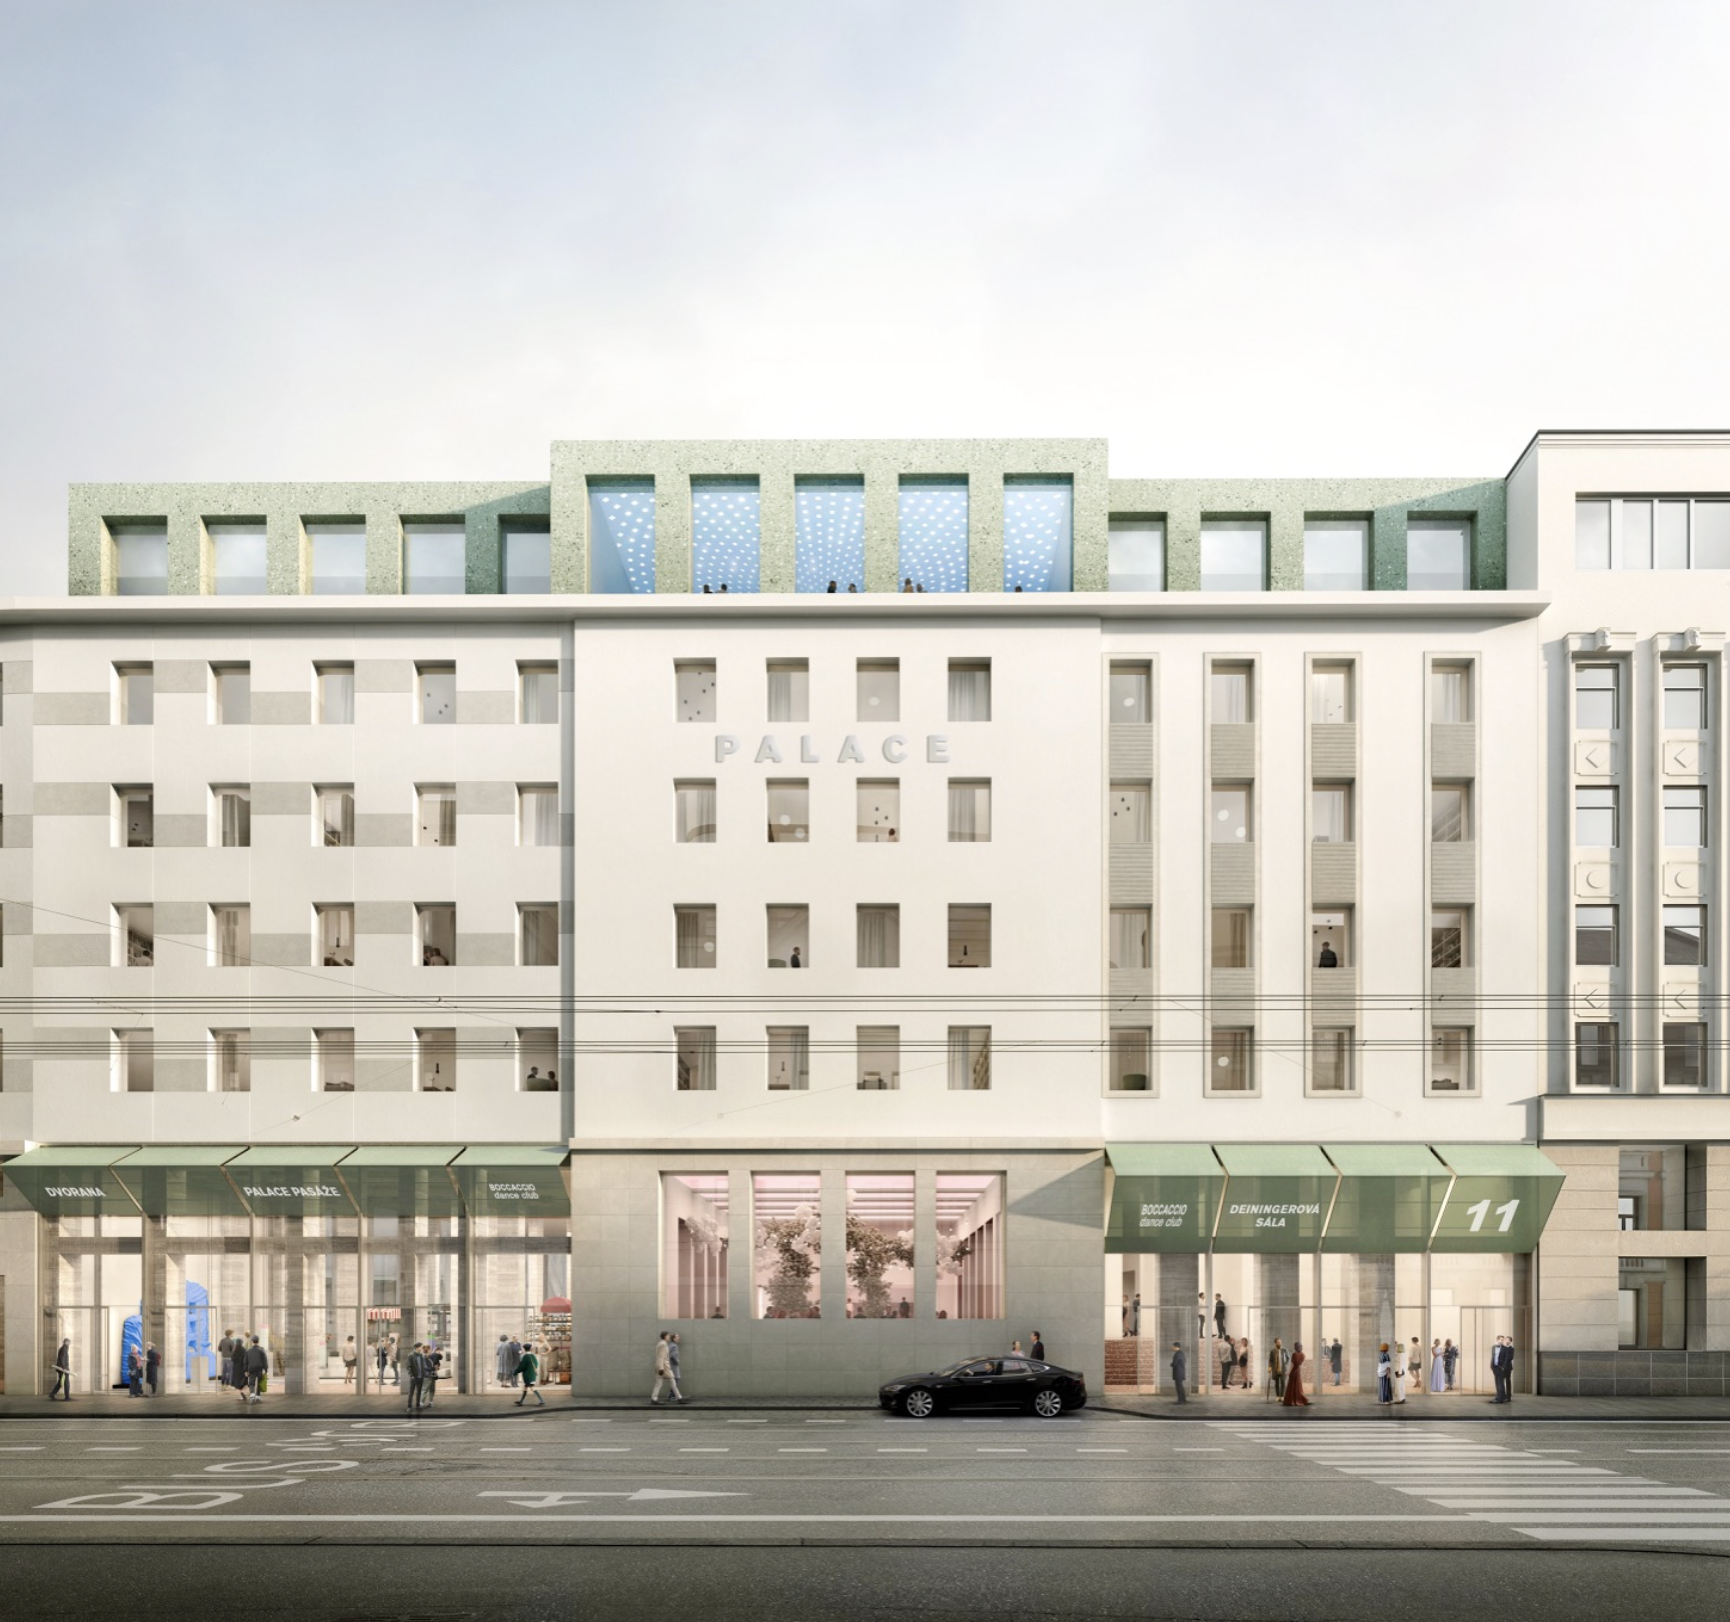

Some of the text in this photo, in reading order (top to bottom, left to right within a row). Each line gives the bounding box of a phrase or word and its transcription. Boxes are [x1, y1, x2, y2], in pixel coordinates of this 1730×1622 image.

[715, 734, 950, 764] PALACE
[44, 1187, 107, 1197] DVORANA
[242, 1186, 292, 1197] PALACE
[488, 1183, 536, 1191] BOCCACCIO
[494, 1191, 539, 1200] dance club
[1141, 1204, 1188, 1216] BOCCACCIO
[1229, 1203, 1320, 1214] DEININGEROVÁ
[1466, 1199, 1520, 1232] 11
[1139, 1216, 1183, 1227] dance club
[1255, 1216, 1286, 1227] SÁLA
[30, 1460, 360, 1510] BUS
